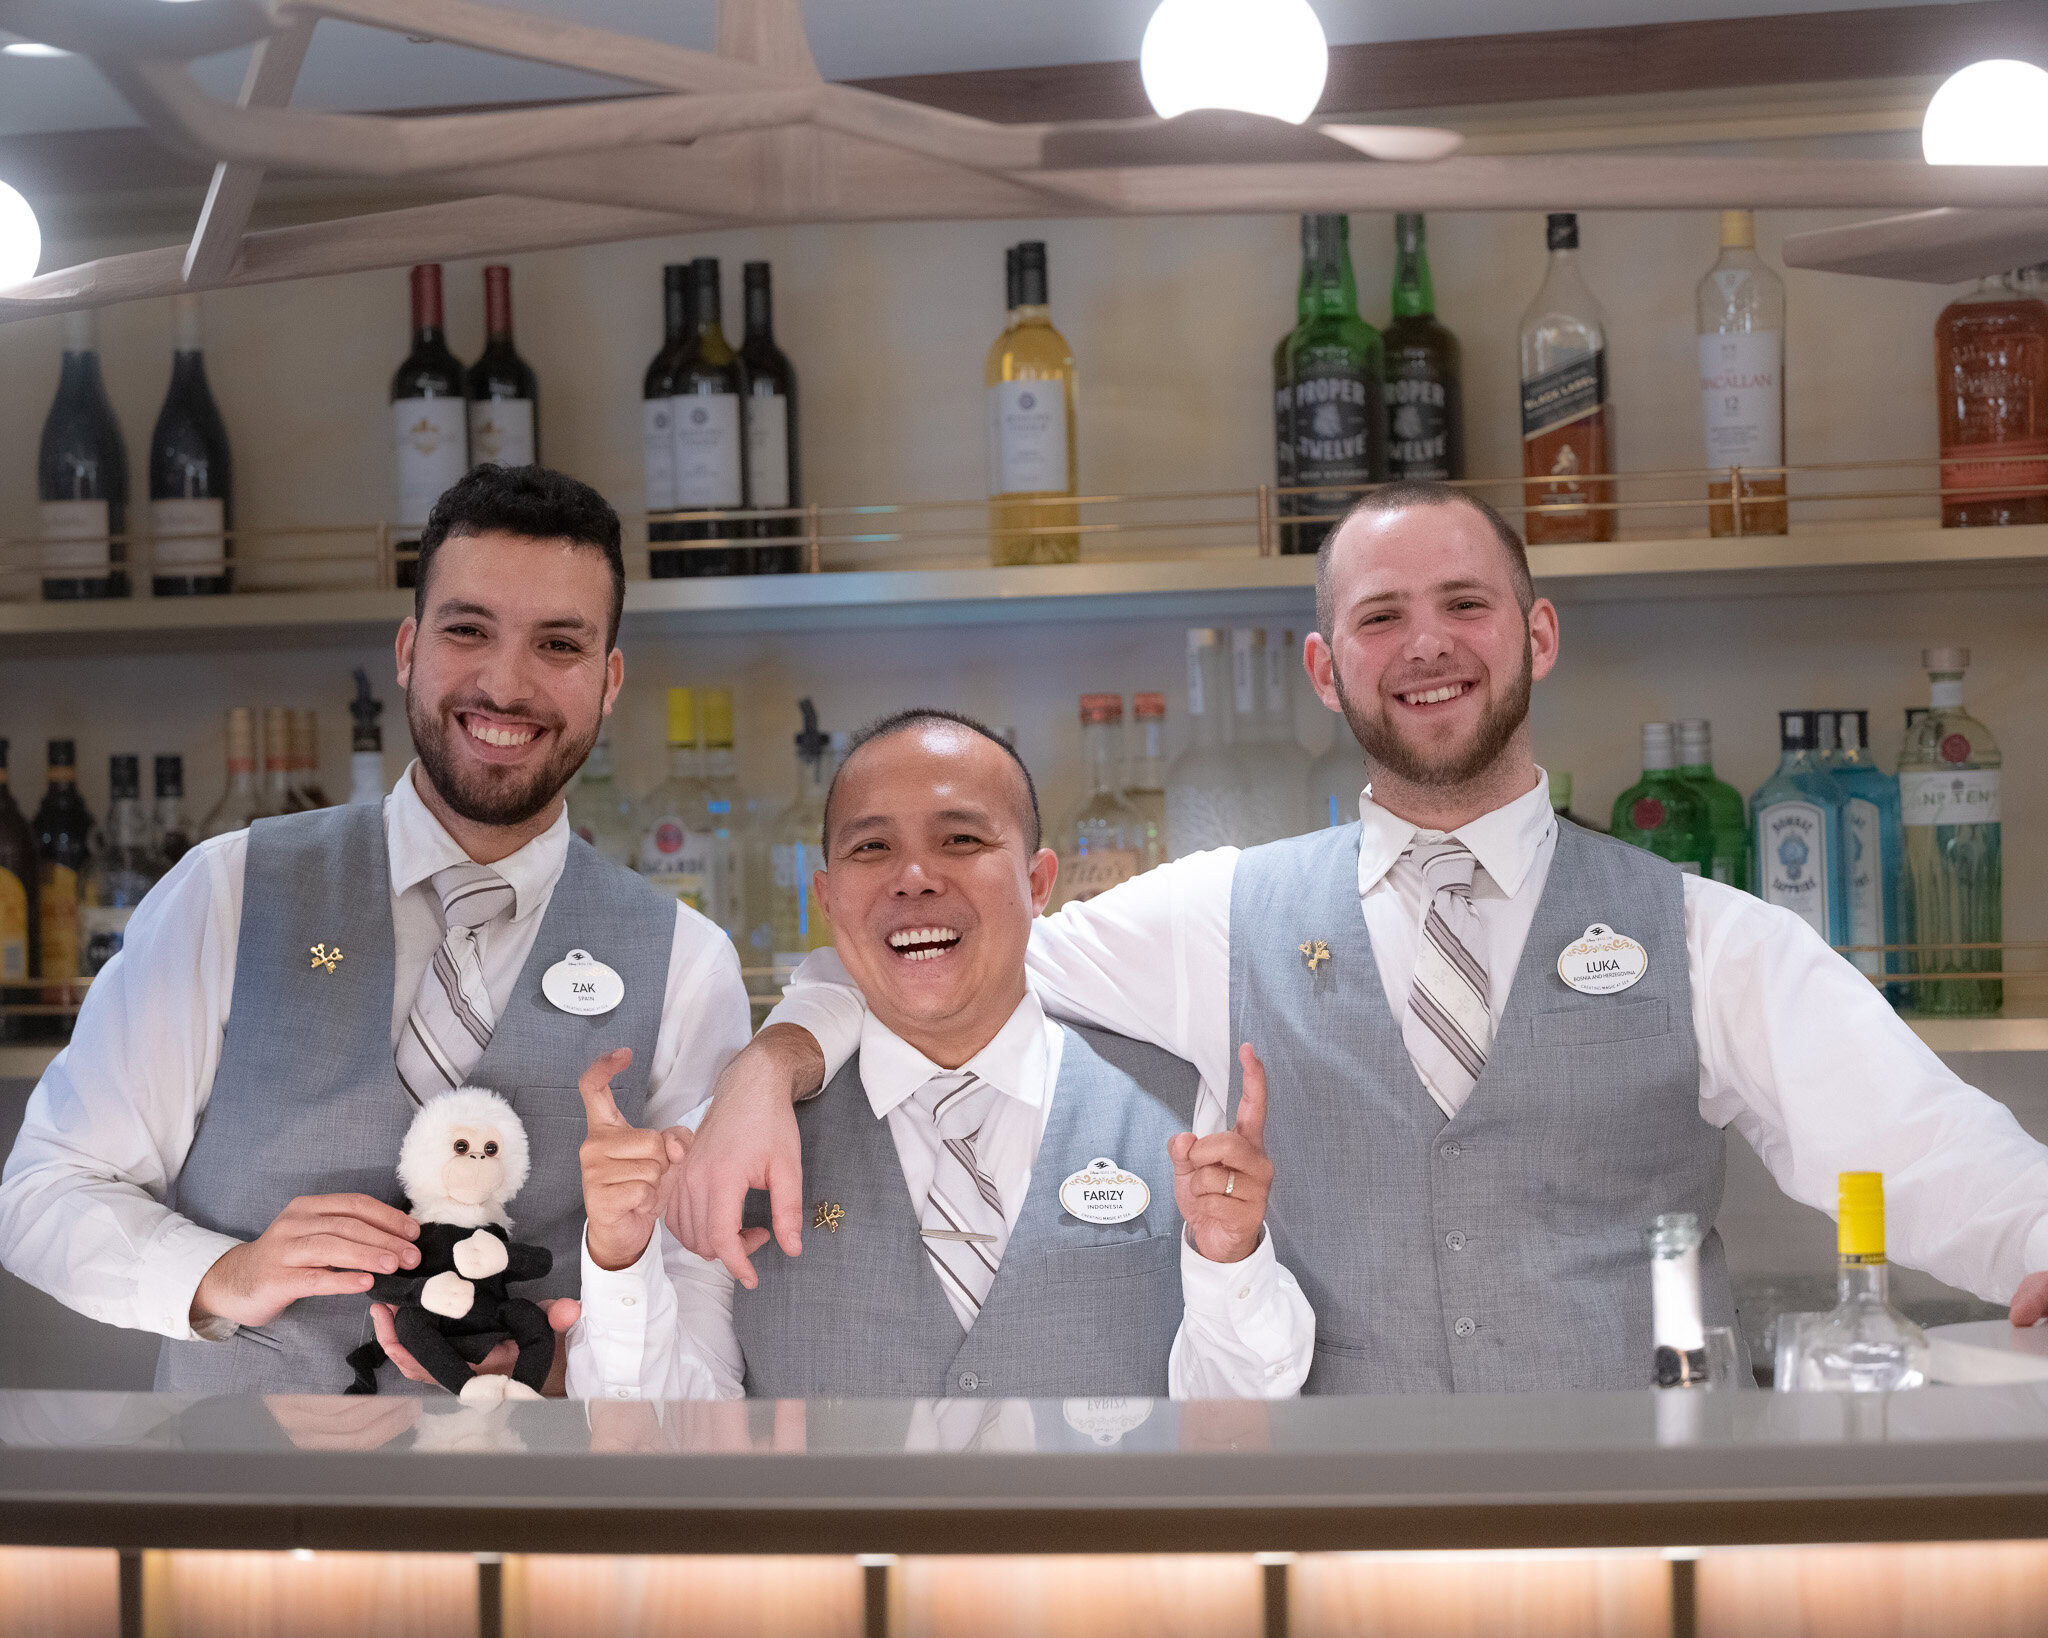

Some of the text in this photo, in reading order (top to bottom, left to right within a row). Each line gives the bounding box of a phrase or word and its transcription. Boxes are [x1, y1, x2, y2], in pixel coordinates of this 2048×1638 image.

[1296, 377, 1365, 408] PROPER
[1298, 432, 1367, 462] TWELVE
[1586, 959, 1620, 973] LUKA
[1603, 970, 1636, 978] HERZEGOVINA
[572, 982, 596, 993] ZAK
[1083, 1190, 1124, 1201] FARIZY
